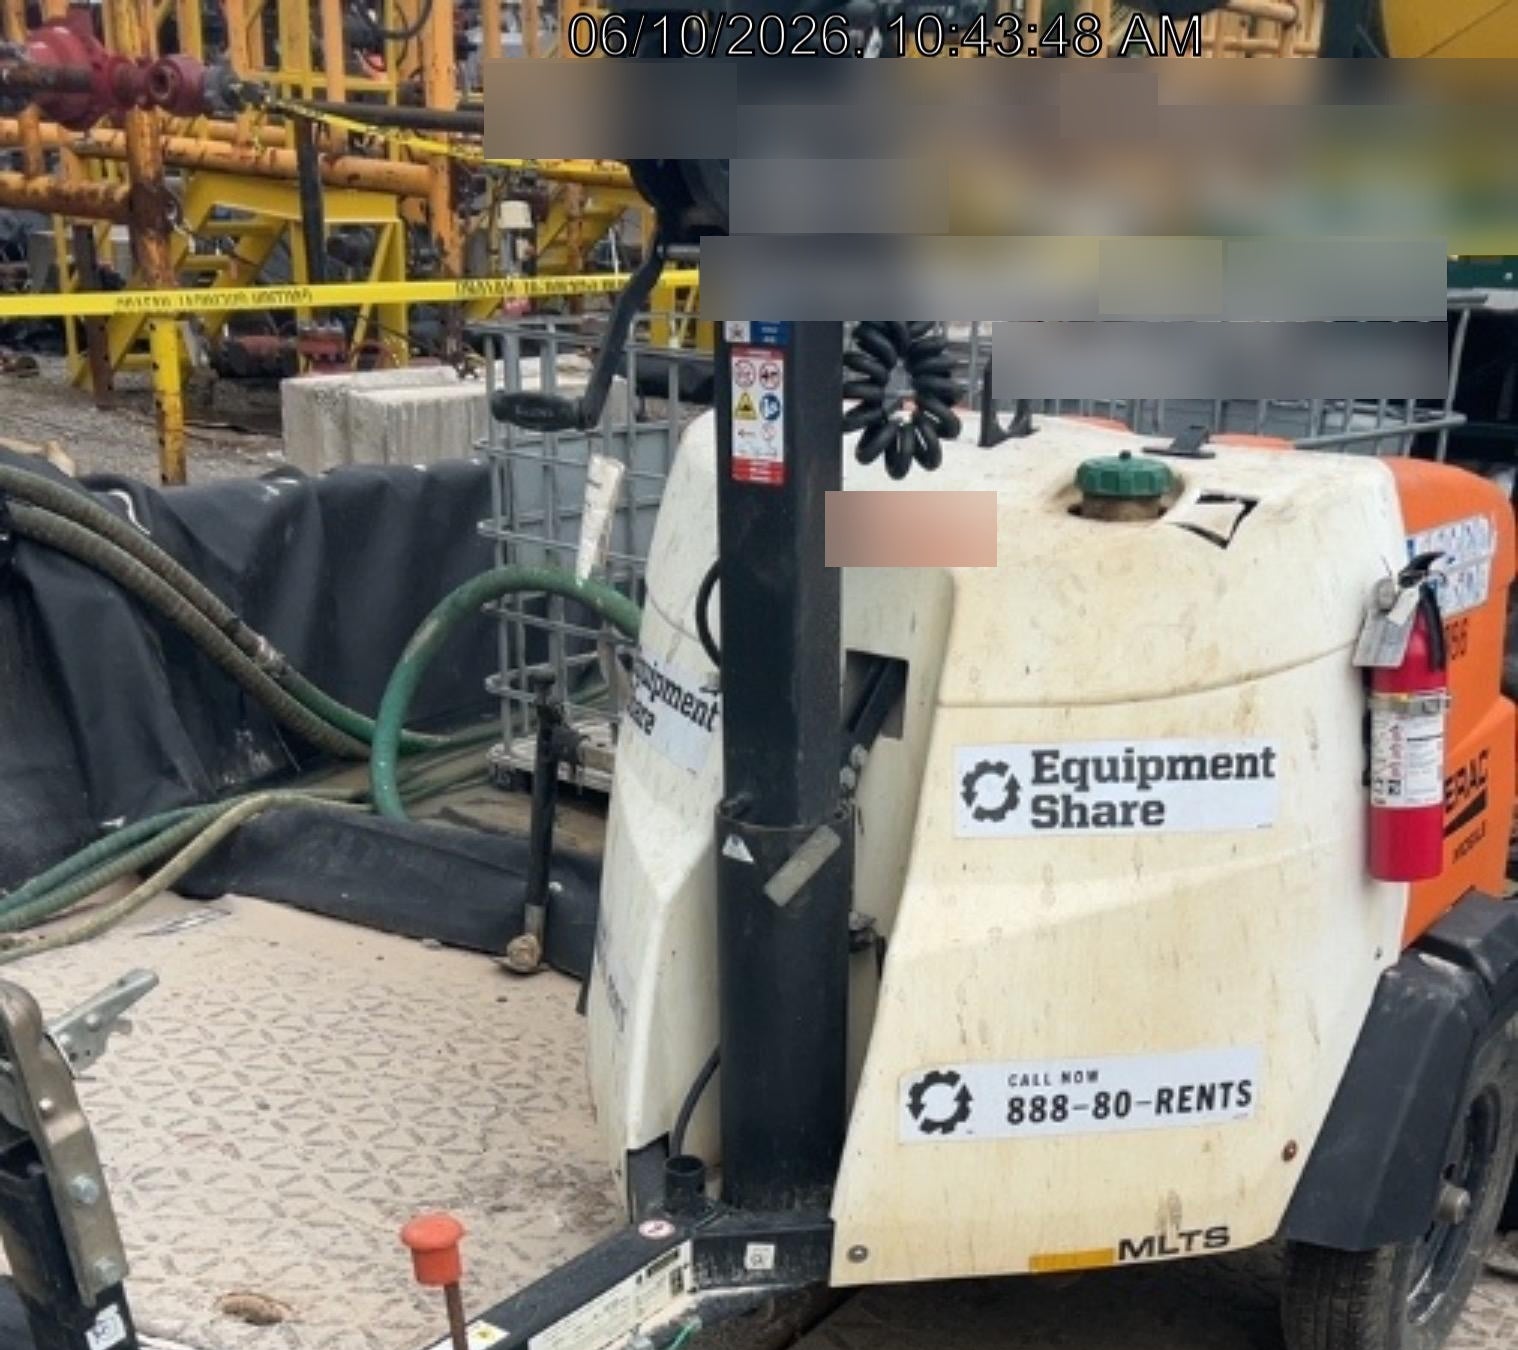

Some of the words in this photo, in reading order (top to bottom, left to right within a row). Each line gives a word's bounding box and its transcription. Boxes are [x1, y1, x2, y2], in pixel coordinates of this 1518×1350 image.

[1031, 747, 1276, 792] Equipment
[1443, 748, 1489, 814] ERAC
[1031, 794, 1166, 829] Share
[1007, 1073, 1052, 1088] CALL
[1061, 1070, 1100, 1084] NOW
[1007, 1079, 1253, 1126] 888-80-RENTS
[1118, 1226, 1230, 1261] MLTS
